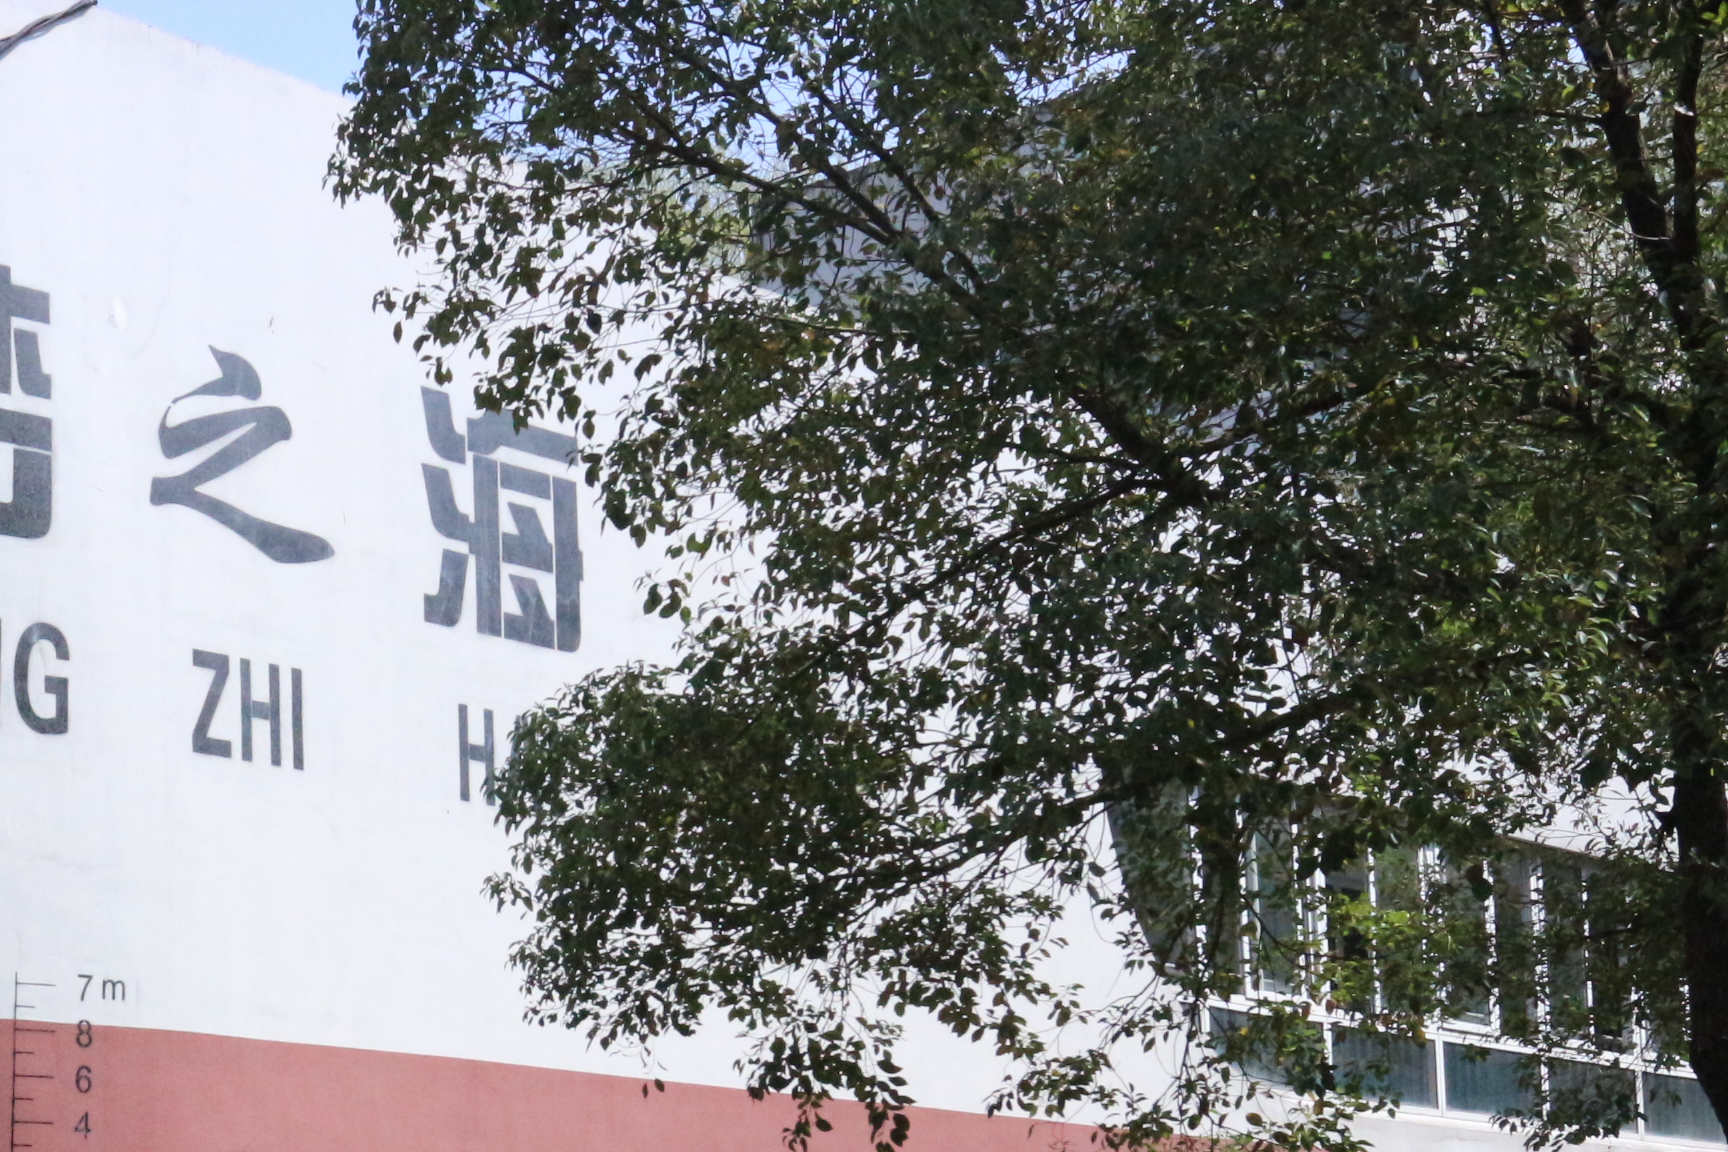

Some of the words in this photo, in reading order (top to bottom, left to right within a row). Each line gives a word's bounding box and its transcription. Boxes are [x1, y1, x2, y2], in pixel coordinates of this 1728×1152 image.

[192, 648, 305, 771] ZHI
[75, 1019, 93, 1048] 8
[74, 1065, 92, 1094] 6
[73, 1111, 92, 1139] 4
